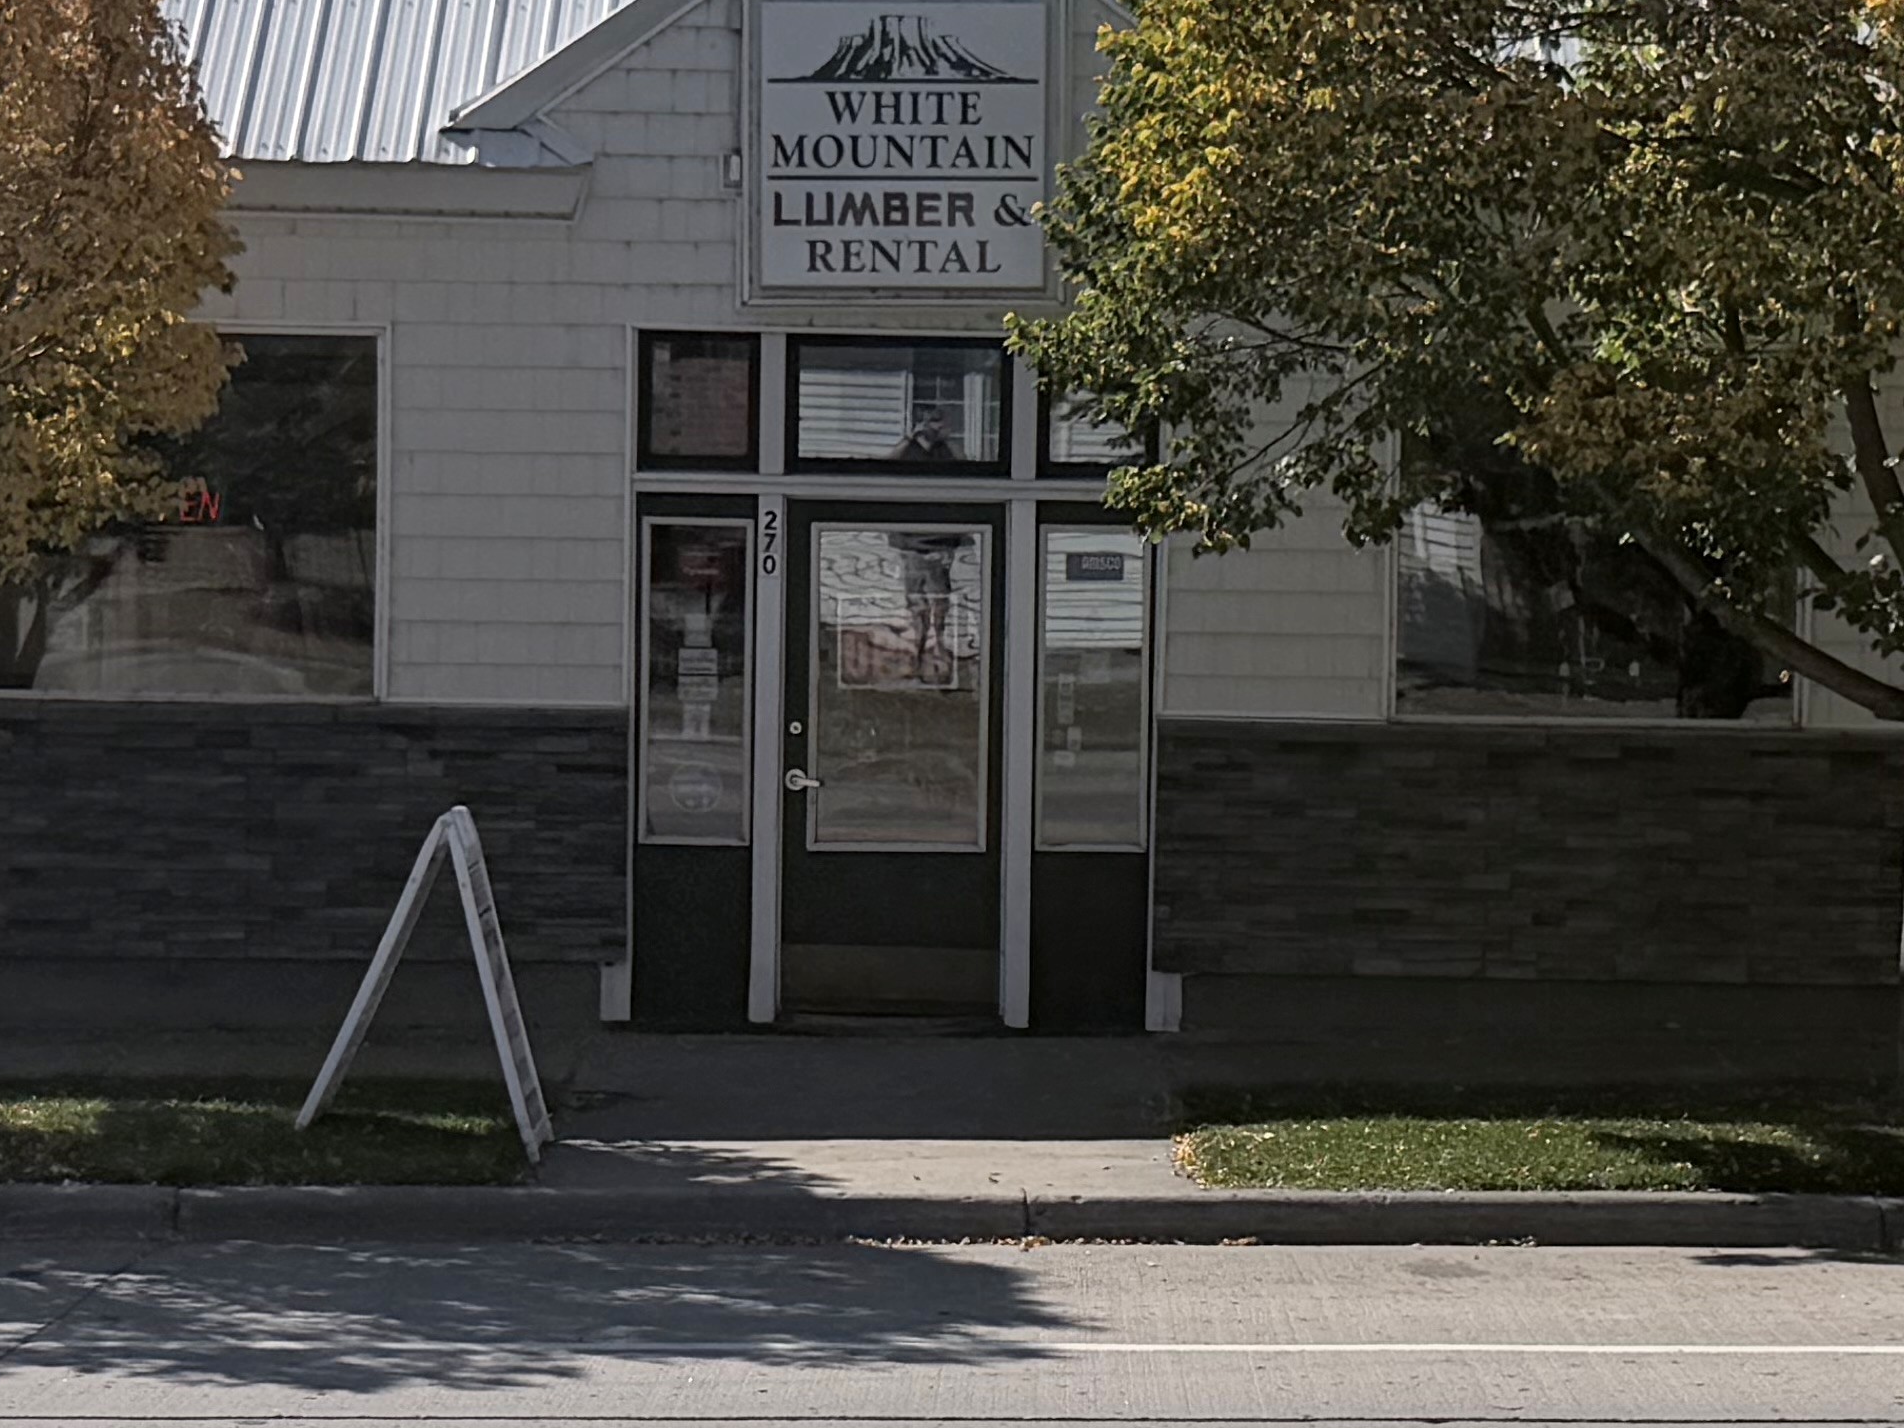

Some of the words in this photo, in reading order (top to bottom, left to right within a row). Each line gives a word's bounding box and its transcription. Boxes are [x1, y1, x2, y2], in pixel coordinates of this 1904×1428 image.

[825, 90, 983, 126] WHITE
[771, 134, 1036, 170] MOUNTAIN
[773, 191, 975, 228] LUMBER
[994, 193, 1033, 228] &
[806, 239, 1002, 274] RENTAL
[763, 510, 778, 575] 270
